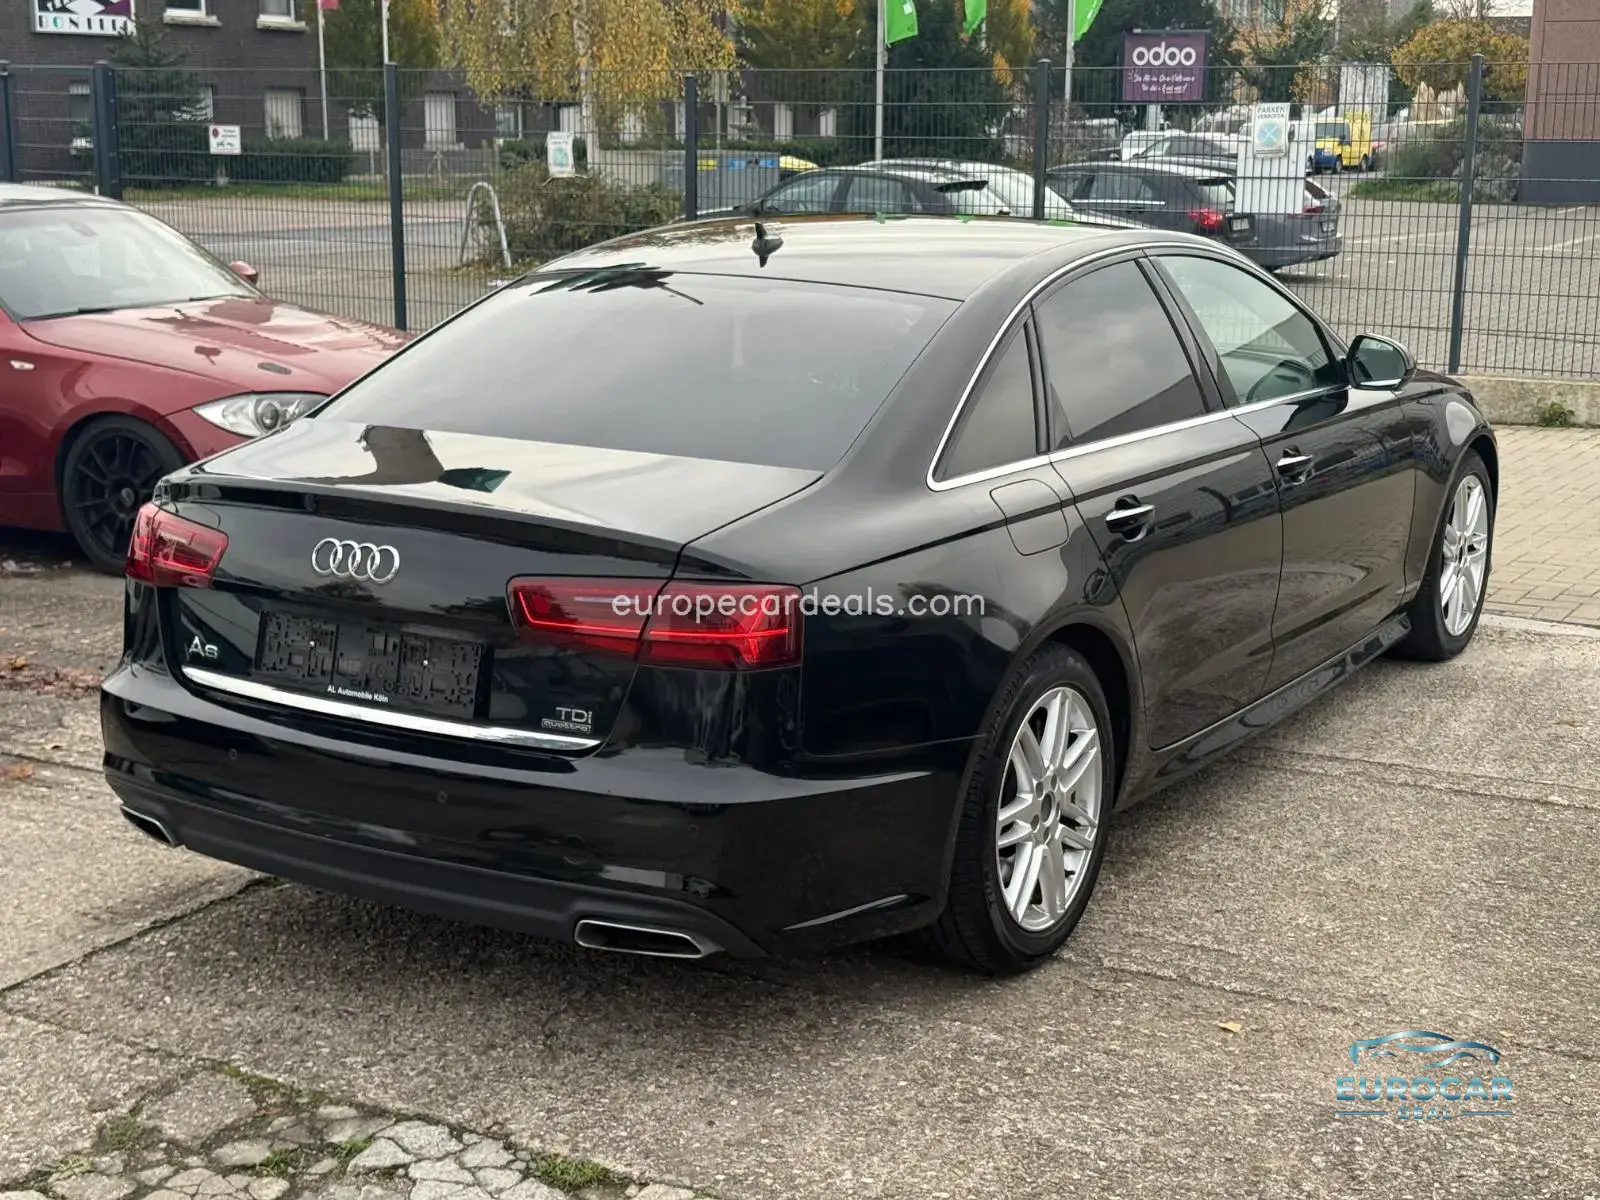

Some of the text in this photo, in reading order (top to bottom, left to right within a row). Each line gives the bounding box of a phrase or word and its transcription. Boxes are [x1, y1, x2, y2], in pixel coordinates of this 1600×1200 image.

[1132, 41, 1197, 66] odoo
[1257, 106, 1285, 114] PARKEN
[188, 635, 219, 659] A6
[327, 684, 389, 703] AL Automobile Köln
